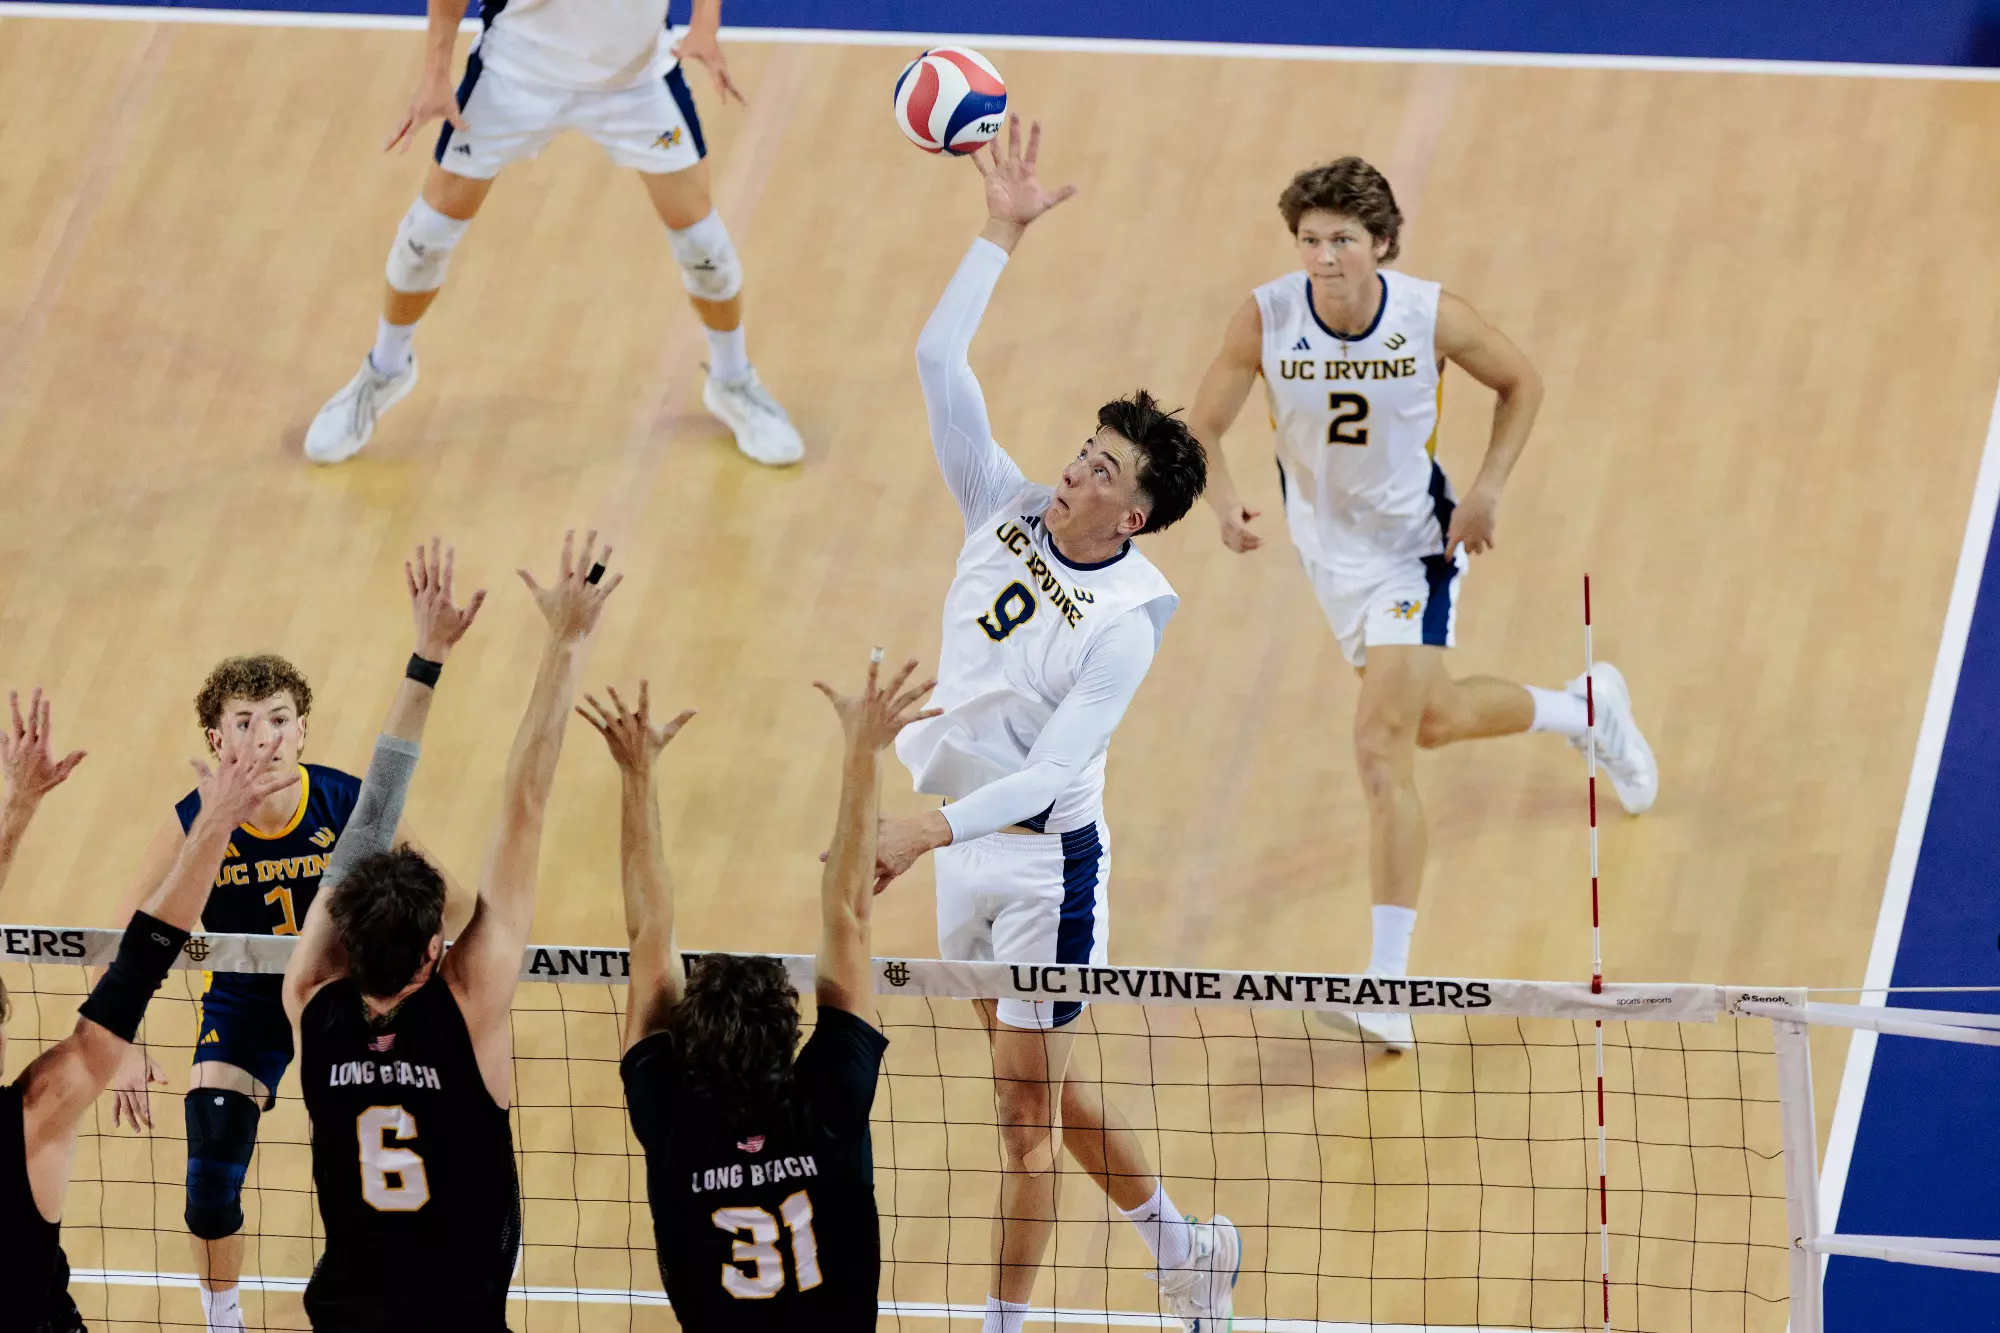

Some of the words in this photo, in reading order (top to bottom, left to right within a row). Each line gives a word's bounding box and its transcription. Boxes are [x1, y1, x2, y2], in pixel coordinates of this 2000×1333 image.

[1280, 360, 1315, 380] UC
[1324, 357, 1416, 380] IRVINE
[1326, 391, 1370, 446] 2
[996, 520, 1031, 557] UC
[976, 579, 1038, 643] 9
[255, 852, 332, 883] IRVIN
[264, 885, 304, 936] 1
[0, 929, 86, 958] ERS
[1010, 965, 1067, 994] UC
[1078, 967, 1221, 1000] IRVINE
[1232, 974, 1493, 1009] ANTEATERS
[1751, 995, 1785, 1003] Senoh
[330, 1060, 376, 1087] LONG
[356, 1104, 431, 1212] 6
[692, 1163, 744, 1194] LONG
[711, 1188, 823, 1300] 31
